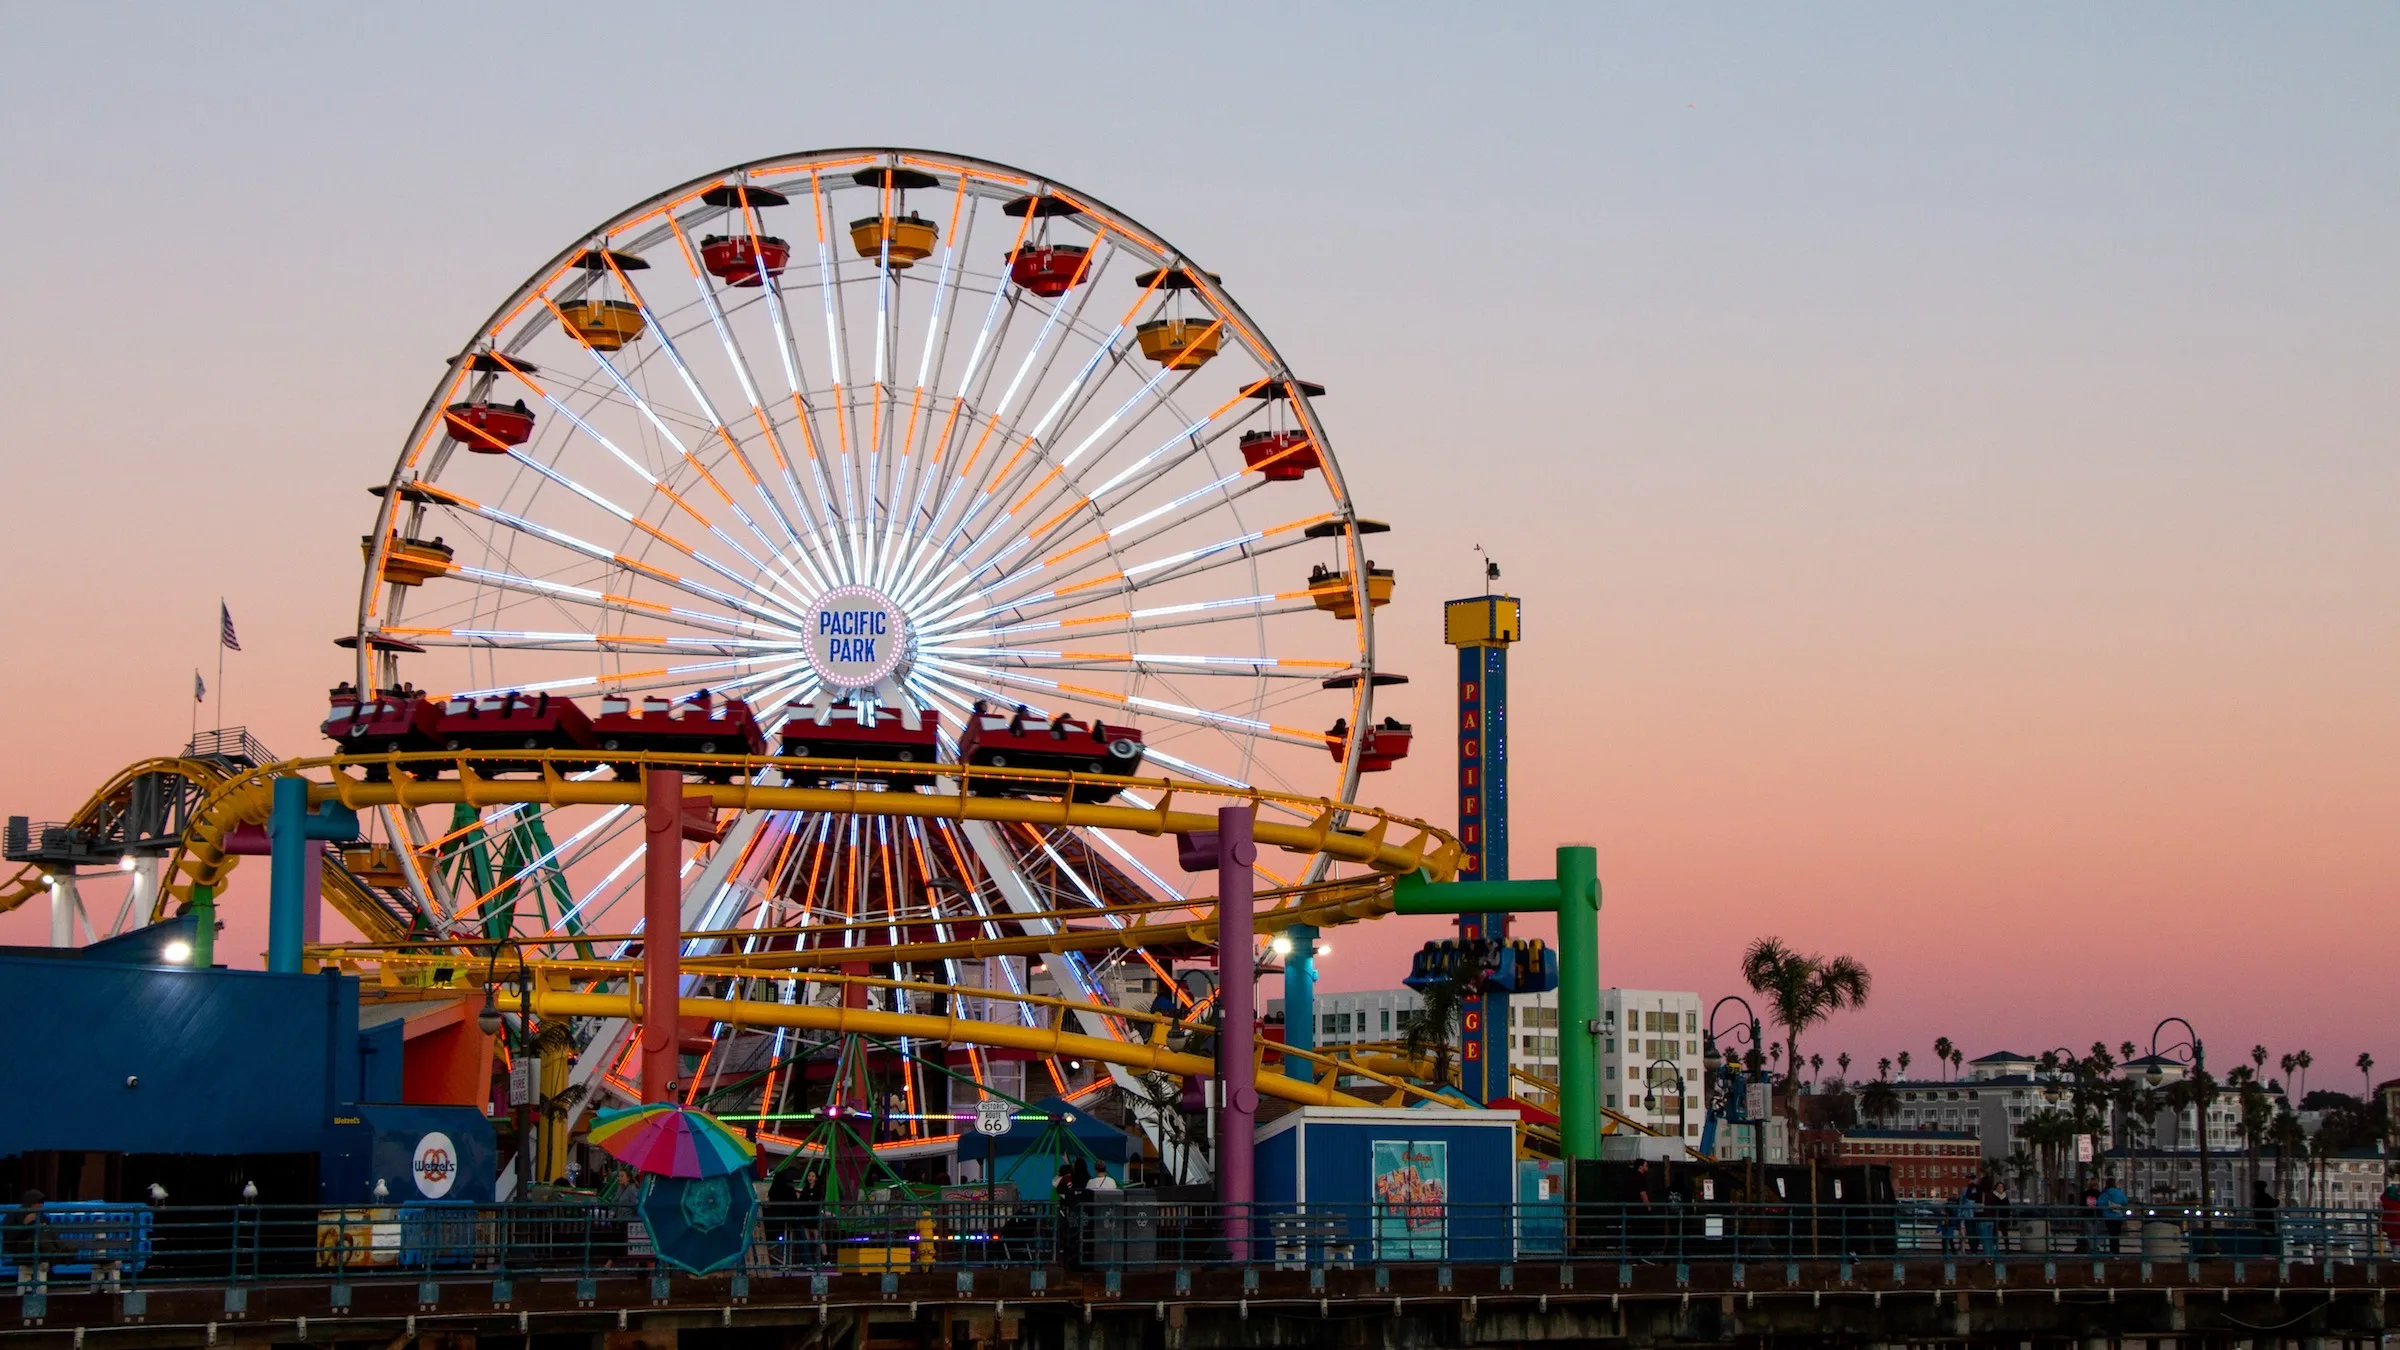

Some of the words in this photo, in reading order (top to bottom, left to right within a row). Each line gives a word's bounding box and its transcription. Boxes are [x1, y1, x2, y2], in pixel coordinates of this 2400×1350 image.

[1265, 448, 1274, 456] 15
[820, 611, 886, 635] PACIFIC
[830, 638, 875, 662] PARK
[1464, 683, 1477, 871] PACIFIC
[512, 1078, 526, 1090] FIRE
[512, 1090, 527, 1102] LANE
[333, 1117, 360, 1125] Wetzel's
[984, 1119, 1002, 1131] 66
[414, 1160, 456, 1172] Wetzel's
